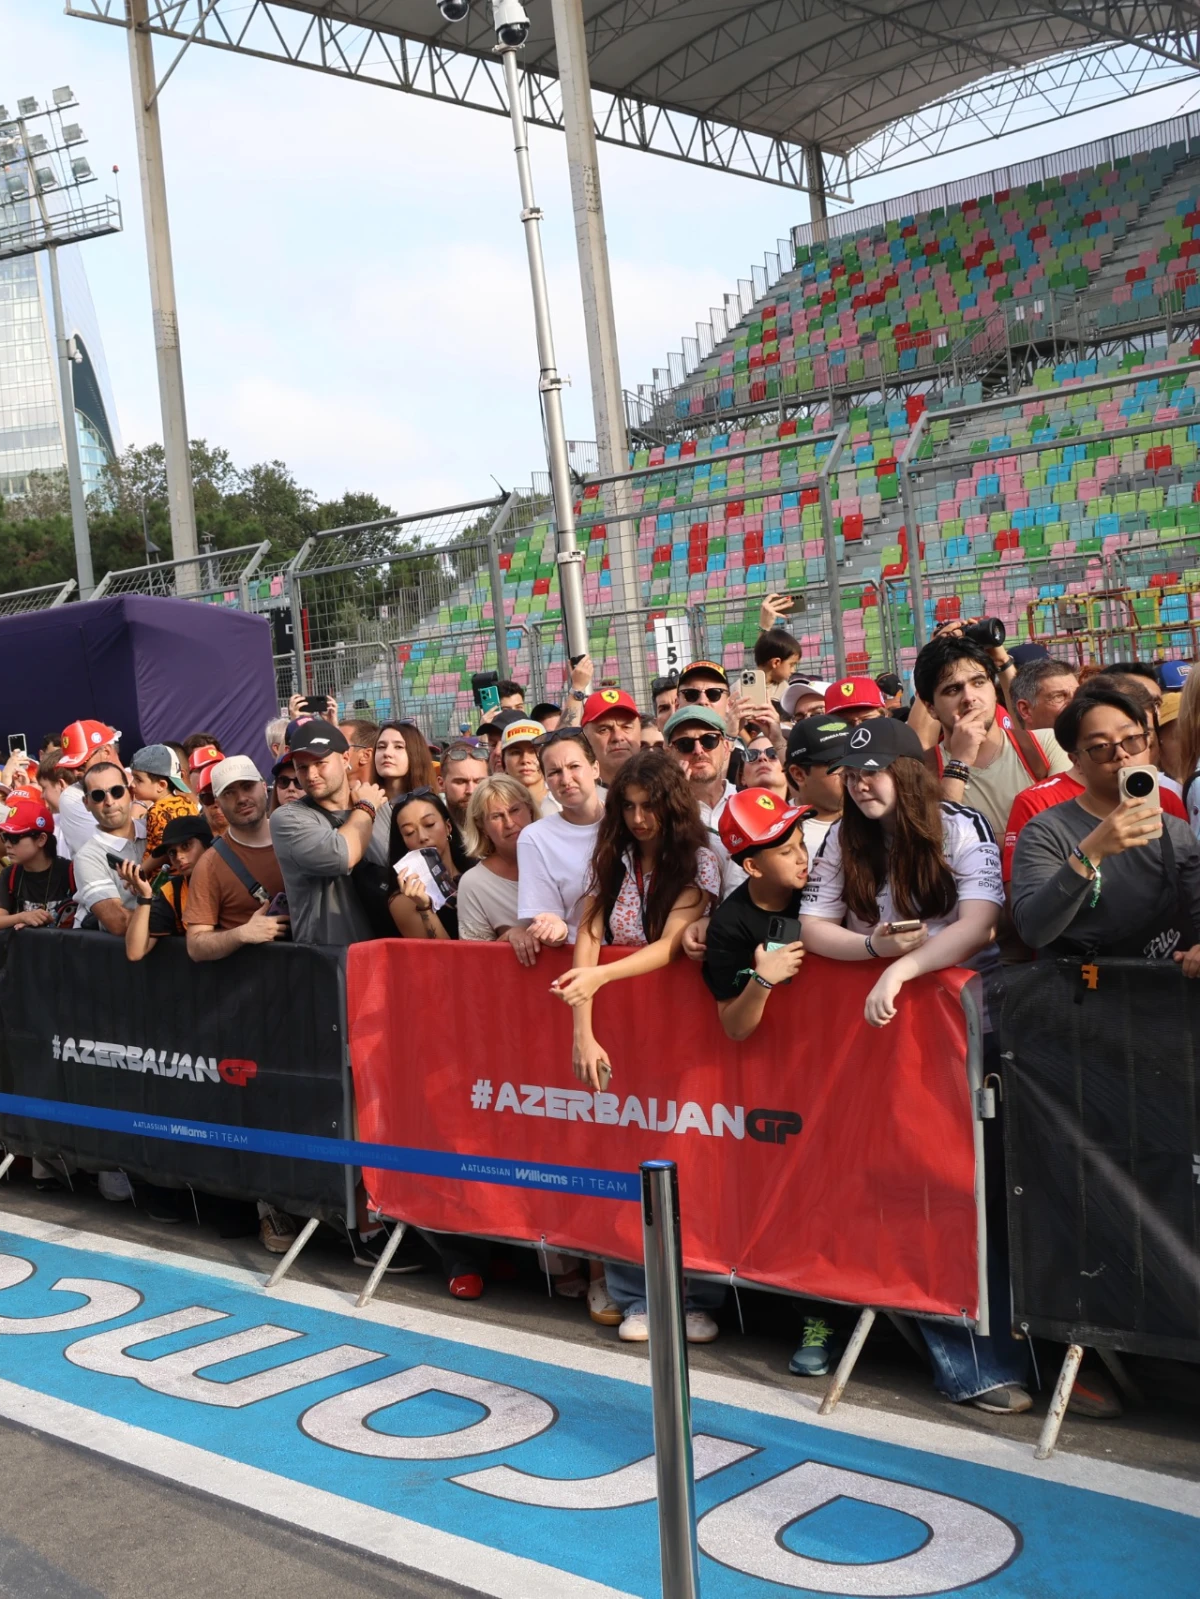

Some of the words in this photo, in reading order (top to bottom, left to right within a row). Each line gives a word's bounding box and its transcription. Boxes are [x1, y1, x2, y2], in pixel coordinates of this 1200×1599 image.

[138, 1121, 168, 1132] ATLASSIAN
[170, 1124, 208, 1139] Williams
[209, 1131, 219, 1140] F1
[221, 1132, 248, 1145] TEAM
[468, 1163, 511, 1177] ATLASSIAN
[515, 1167, 568, 1186] Williams
[572, 1176, 584, 1188] F1
[589, 1178, 628, 1193] TEAM
